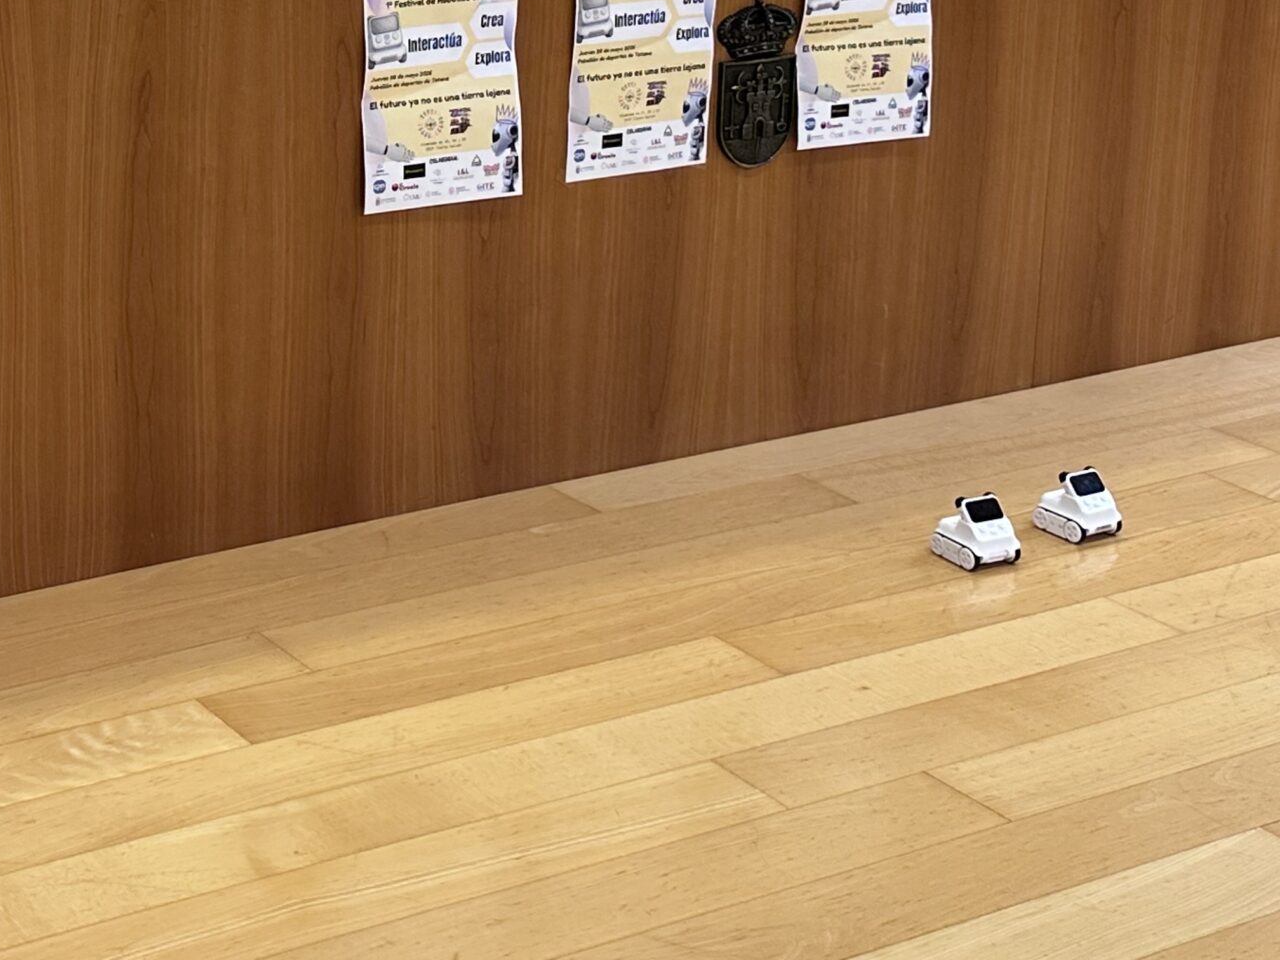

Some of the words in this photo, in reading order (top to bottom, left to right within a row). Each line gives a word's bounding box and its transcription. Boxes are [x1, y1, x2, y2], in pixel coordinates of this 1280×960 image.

[896, 1, 928, 15] Explora
[480, 14, 504, 28] Crea
[614, 8, 666, 28] Interactúa
[676, 26, 709, 42] Explora
[408, 32, 463, 53] Interactúa
[474, 50, 511, 66] Explora
[577, 74, 585, 83] El
[586, 73, 612, 82] futuro
[613, 72, 622, 81] ya
[369, 101, 378, 111] El
[379, 100, 407, 109] futuro
[409, 98, 419, 109] ya
[444, 94, 460, 102] una
